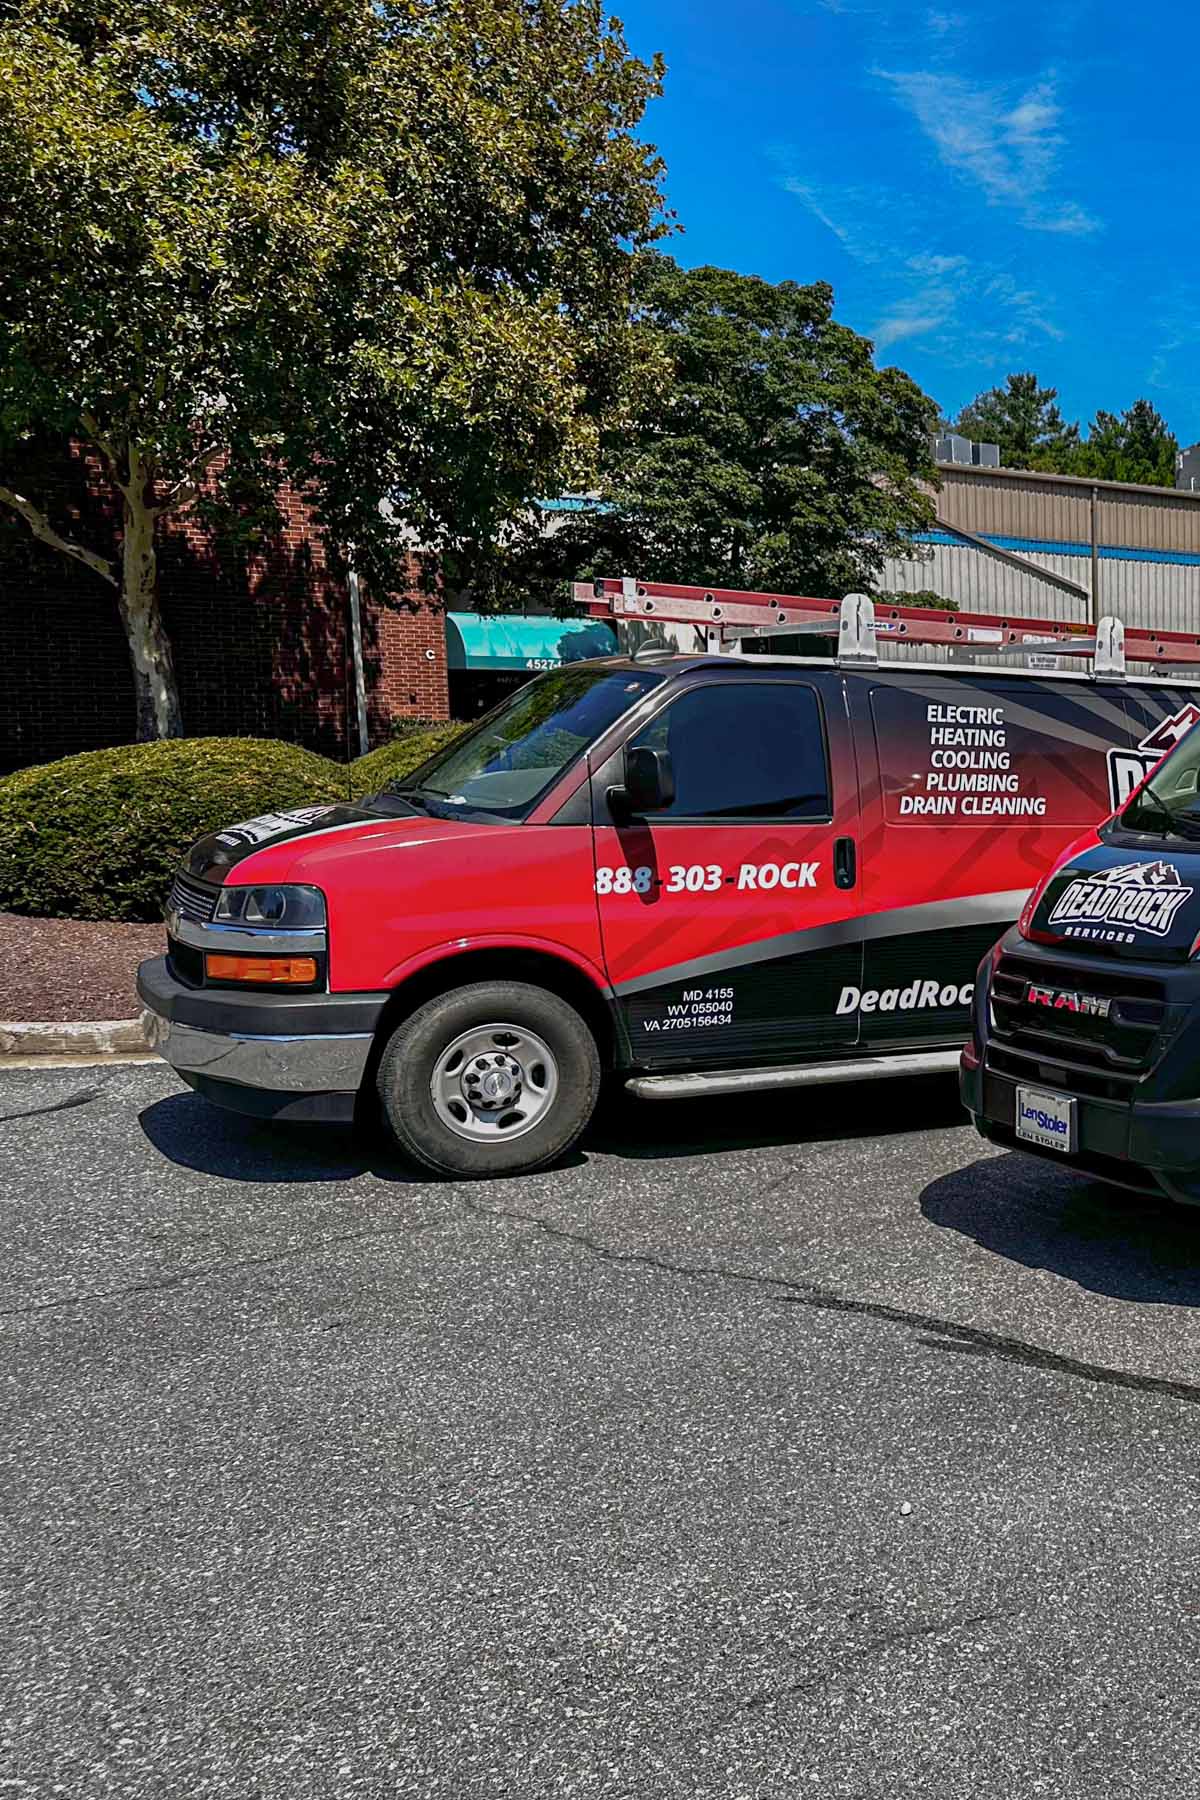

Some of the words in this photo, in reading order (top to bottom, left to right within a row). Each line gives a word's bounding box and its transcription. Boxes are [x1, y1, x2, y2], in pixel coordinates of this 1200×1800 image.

[425, 649, 436, 660] C
[926, 704, 1005, 725] ELECTRIC
[930, 727, 1006, 748] HEATING
[930, 750, 1011, 770] COOLING
[926, 772, 1019, 793] PLUMBING
[900, 796, 957, 815] DRAIN
[960, 796, 1046, 816] CLEANING
[1052, 883, 1119, 920] DEAD
[1108, 888, 1188, 931] ROCK
[1064, 926, 1136, 944] SERVICES
[682, 990, 703, 1002] MD
[705, 987, 734, 1000] 4155
[1027, 985, 1112, 1018] RAM
[667, 1004, 689, 1017] WV
[691, 1001, 733, 1015] 055040
[643, 1020, 661, 1032] VA
[662, 1014, 732, 1031] 2705156434
